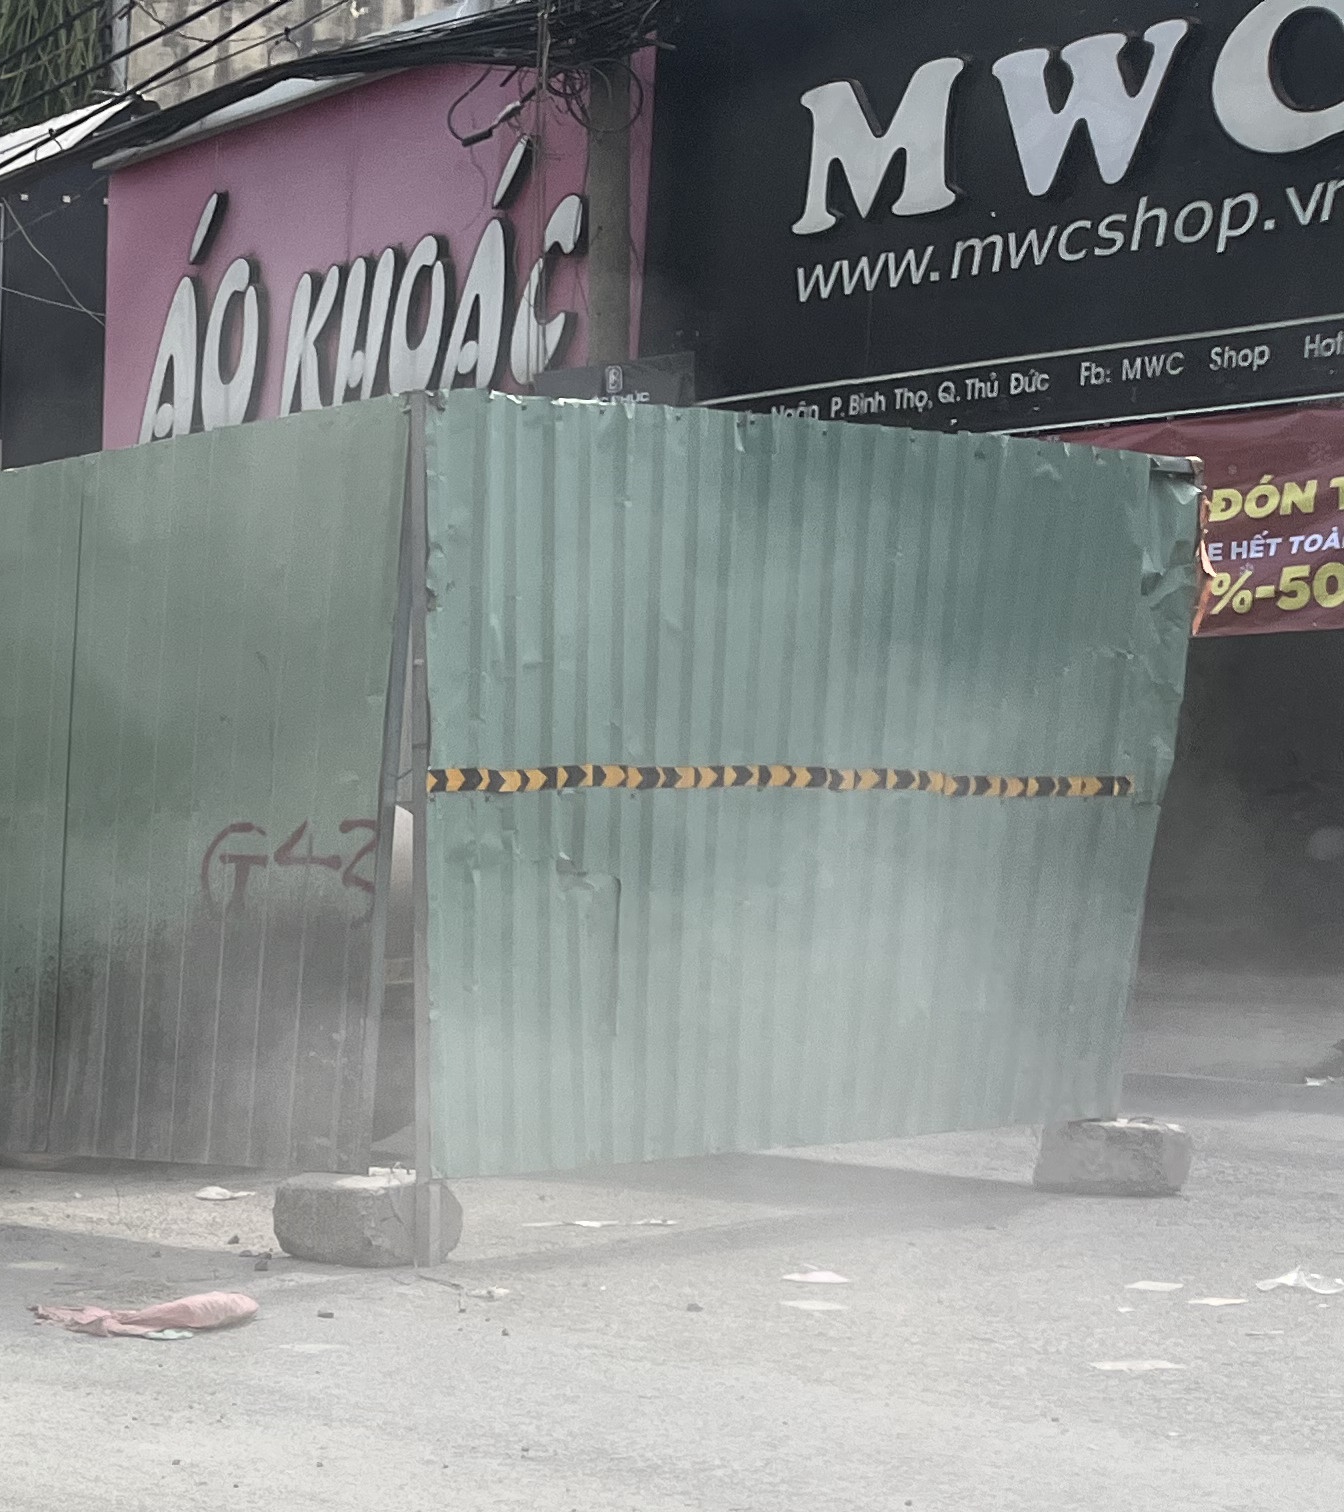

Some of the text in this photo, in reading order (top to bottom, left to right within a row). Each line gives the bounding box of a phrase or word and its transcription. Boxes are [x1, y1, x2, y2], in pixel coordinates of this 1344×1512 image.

[138, 134, 583, 445] ÁO KHOÁC
[1079, 362, 1112, 386] Fb:
[1121, 352, 1185, 381] MWC
[1209, 345, 1271, 371] Shop
[1231, 530, 1282, 561] HẾT
